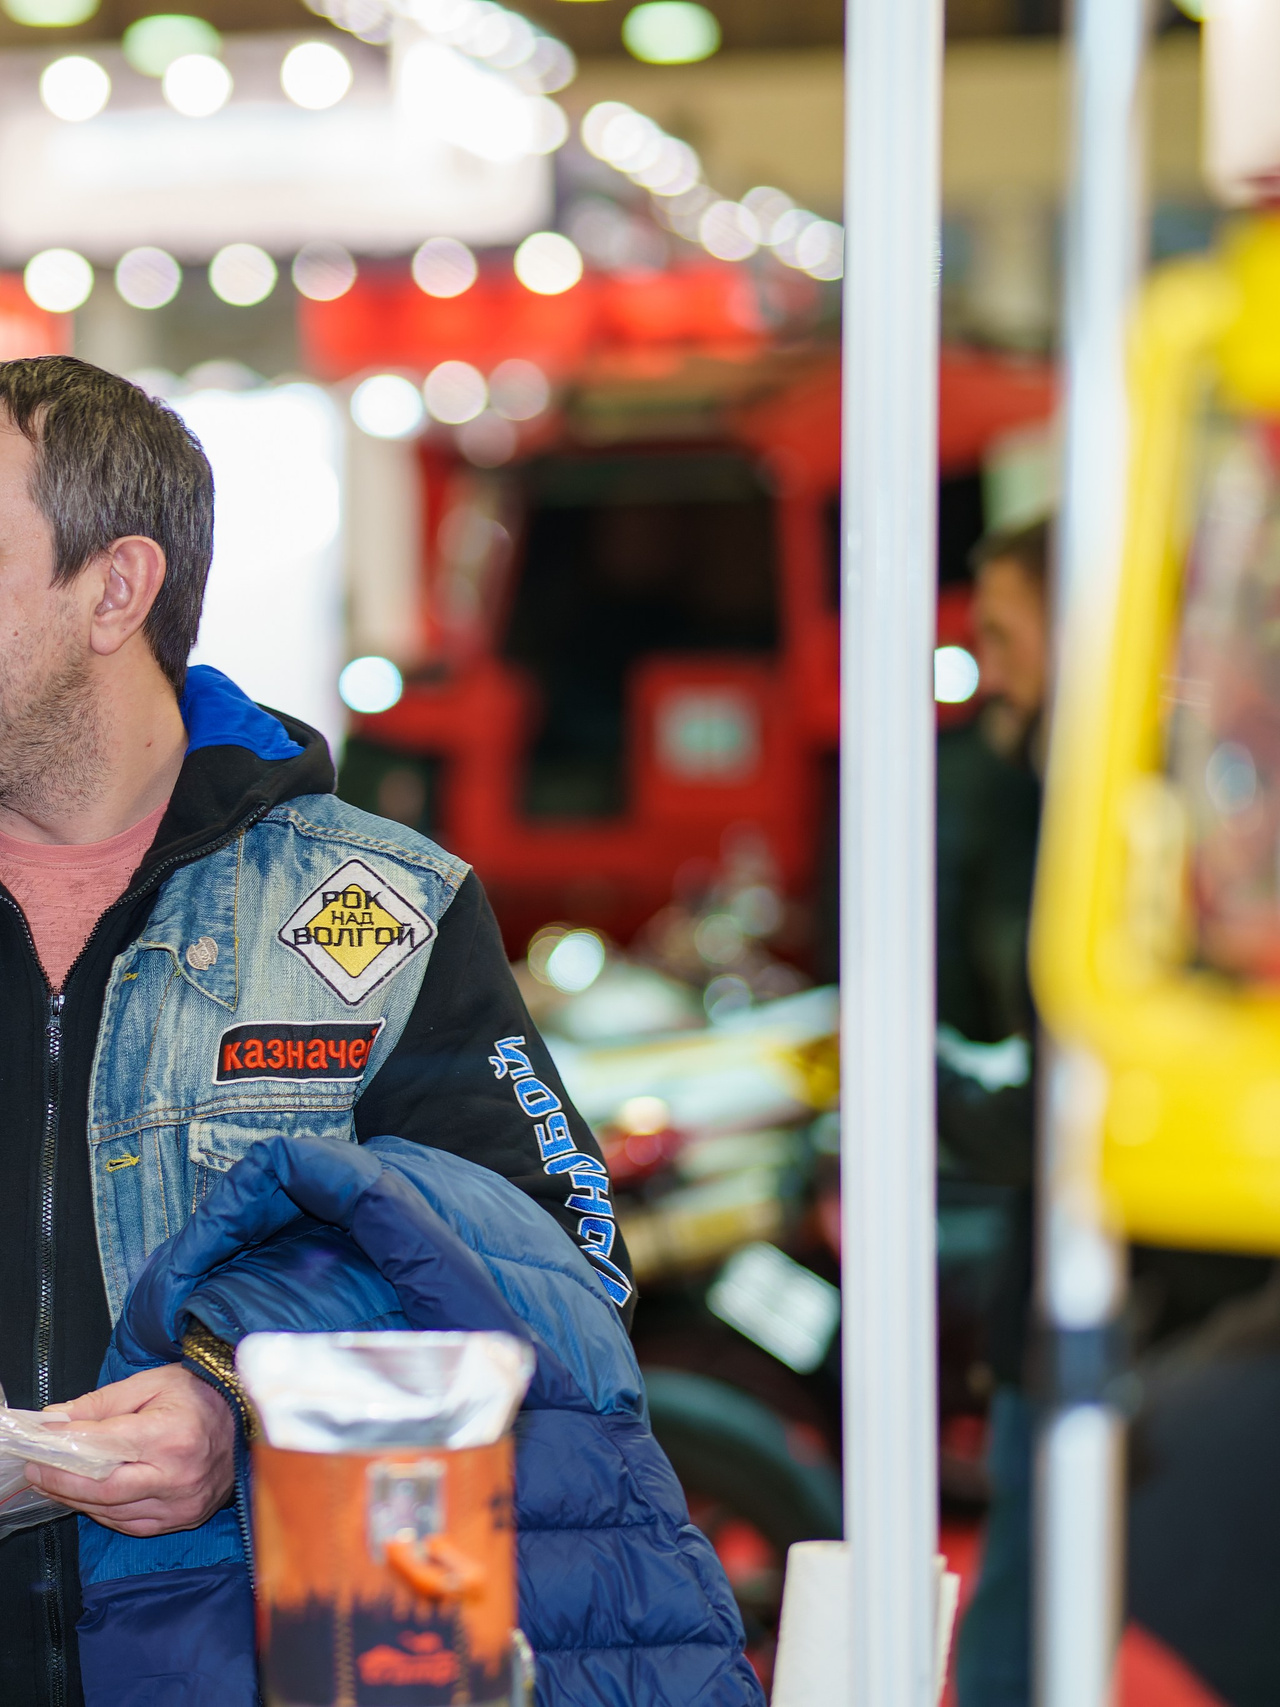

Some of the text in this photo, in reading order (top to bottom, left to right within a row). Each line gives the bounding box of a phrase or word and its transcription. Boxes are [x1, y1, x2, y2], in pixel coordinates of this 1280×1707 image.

[321, 890, 383, 910] РОК
[332, 911, 374, 926] НАД
[293, 923, 415, 947] ВОЛГОЙ
